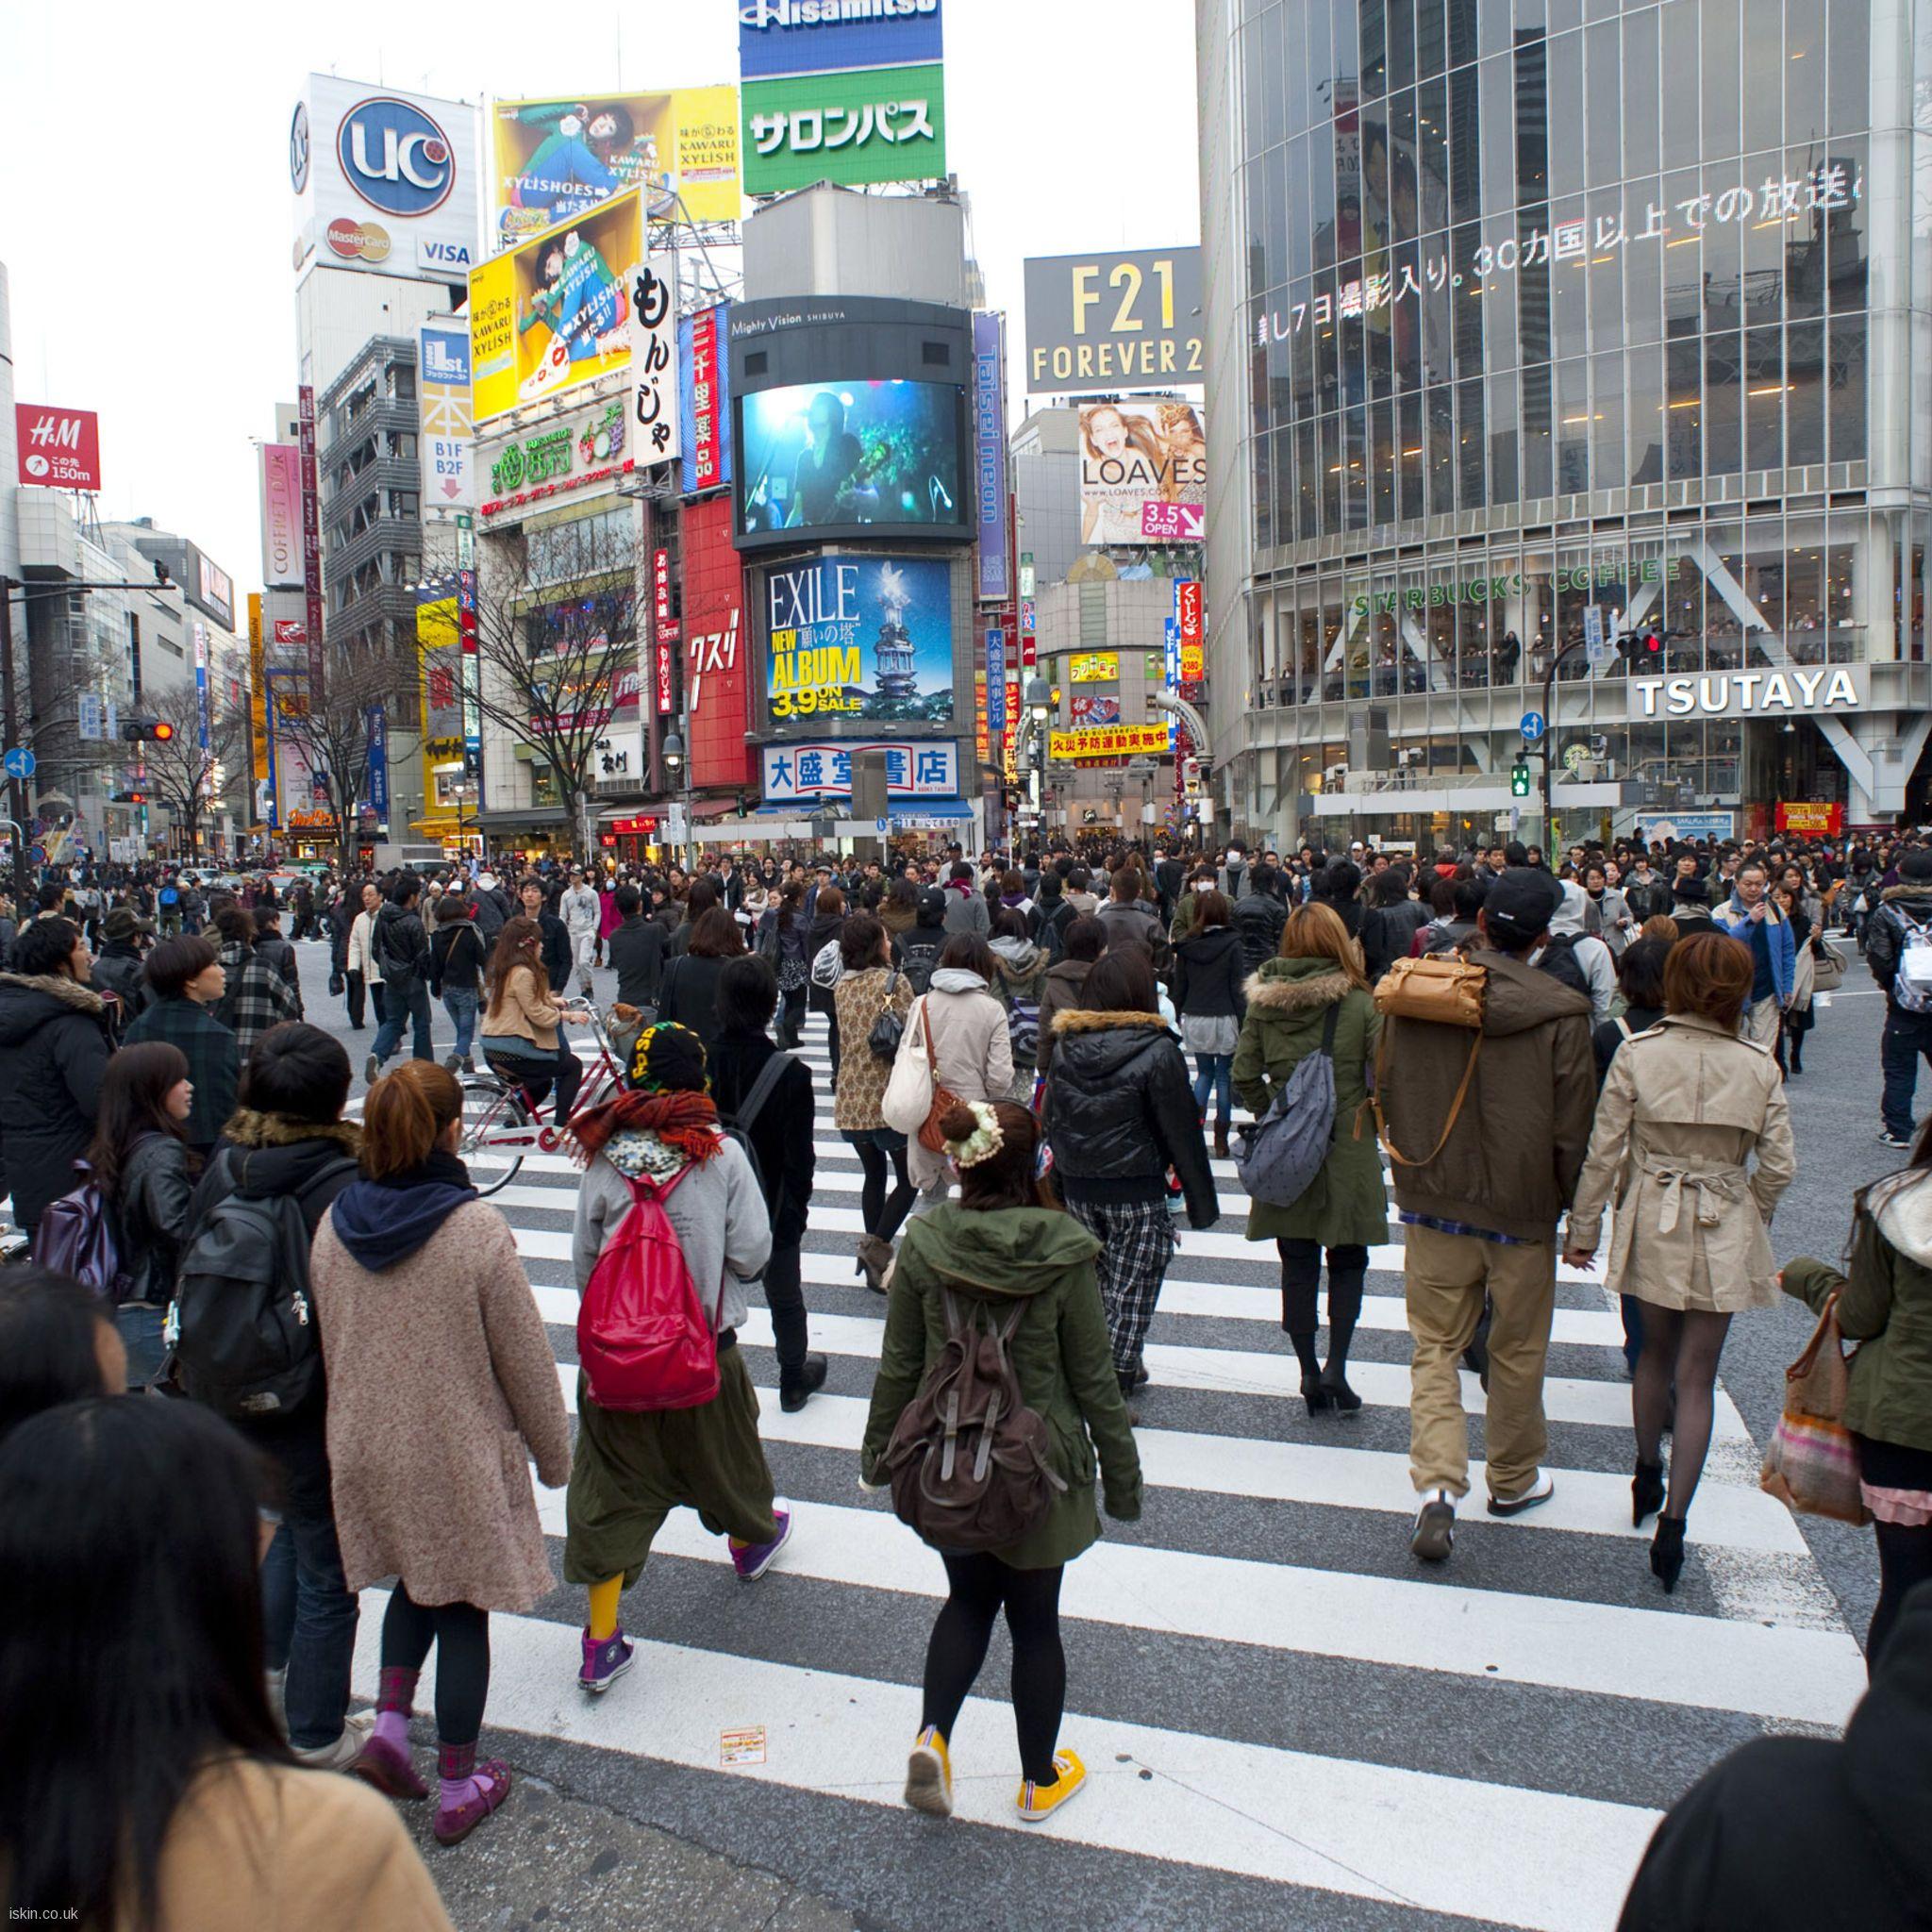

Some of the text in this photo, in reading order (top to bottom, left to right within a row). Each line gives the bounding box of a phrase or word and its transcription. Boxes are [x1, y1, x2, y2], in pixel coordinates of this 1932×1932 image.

[749, 99, 934, 154] サロンパス
[680, 141, 735, 151] KAWARU
[681, 152, 734, 164] XYLISH
[504, 176, 594, 197] XYLISHOES
[329, 230, 390, 249] MasterCard
[425, 242, 471, 264] VISA
[1073, 260, 1174, 334] F21
[732, 311, 845, 337] Mighty Vision SHIBUYA
[474, 331, 511, 358] XYLISH
[633, 267, 671, 454] もんじゃ
[1033, 340, 1177, 381] FOREVER
[422, 384, 474, 440] 本
[30, 415, 81, 451] H&M
[51, 456, 80, 468] この先
[436, 441, 462, 458] B1F
[52, 466, 91, 482] 150m
[436, 460, 463, 475] B2F
[1083, 458, 1207, 485] LOAVES
[982, 446, 998, 524] neon
[1146, 504, 1178, 524] 3.5
[1144, 524, 1178, 536] OPEN
[770, 565, 859, 630] EXILE
[1355, 557, 1681, 617] STARBUCKS COFFEE
[772, 629, 797, 653] NEW
[773, 647, 861, 690] ALBUM
[773, 686, 842, 717] 3.9 ON
[818, 697, 862, 712] SALE
[1636, 670, 1858, 716] TSUTAYA
[1054, 730, 1167, 752] 火災予防運動実施中
[771, 750, 947, 789] 大盛堂書店
